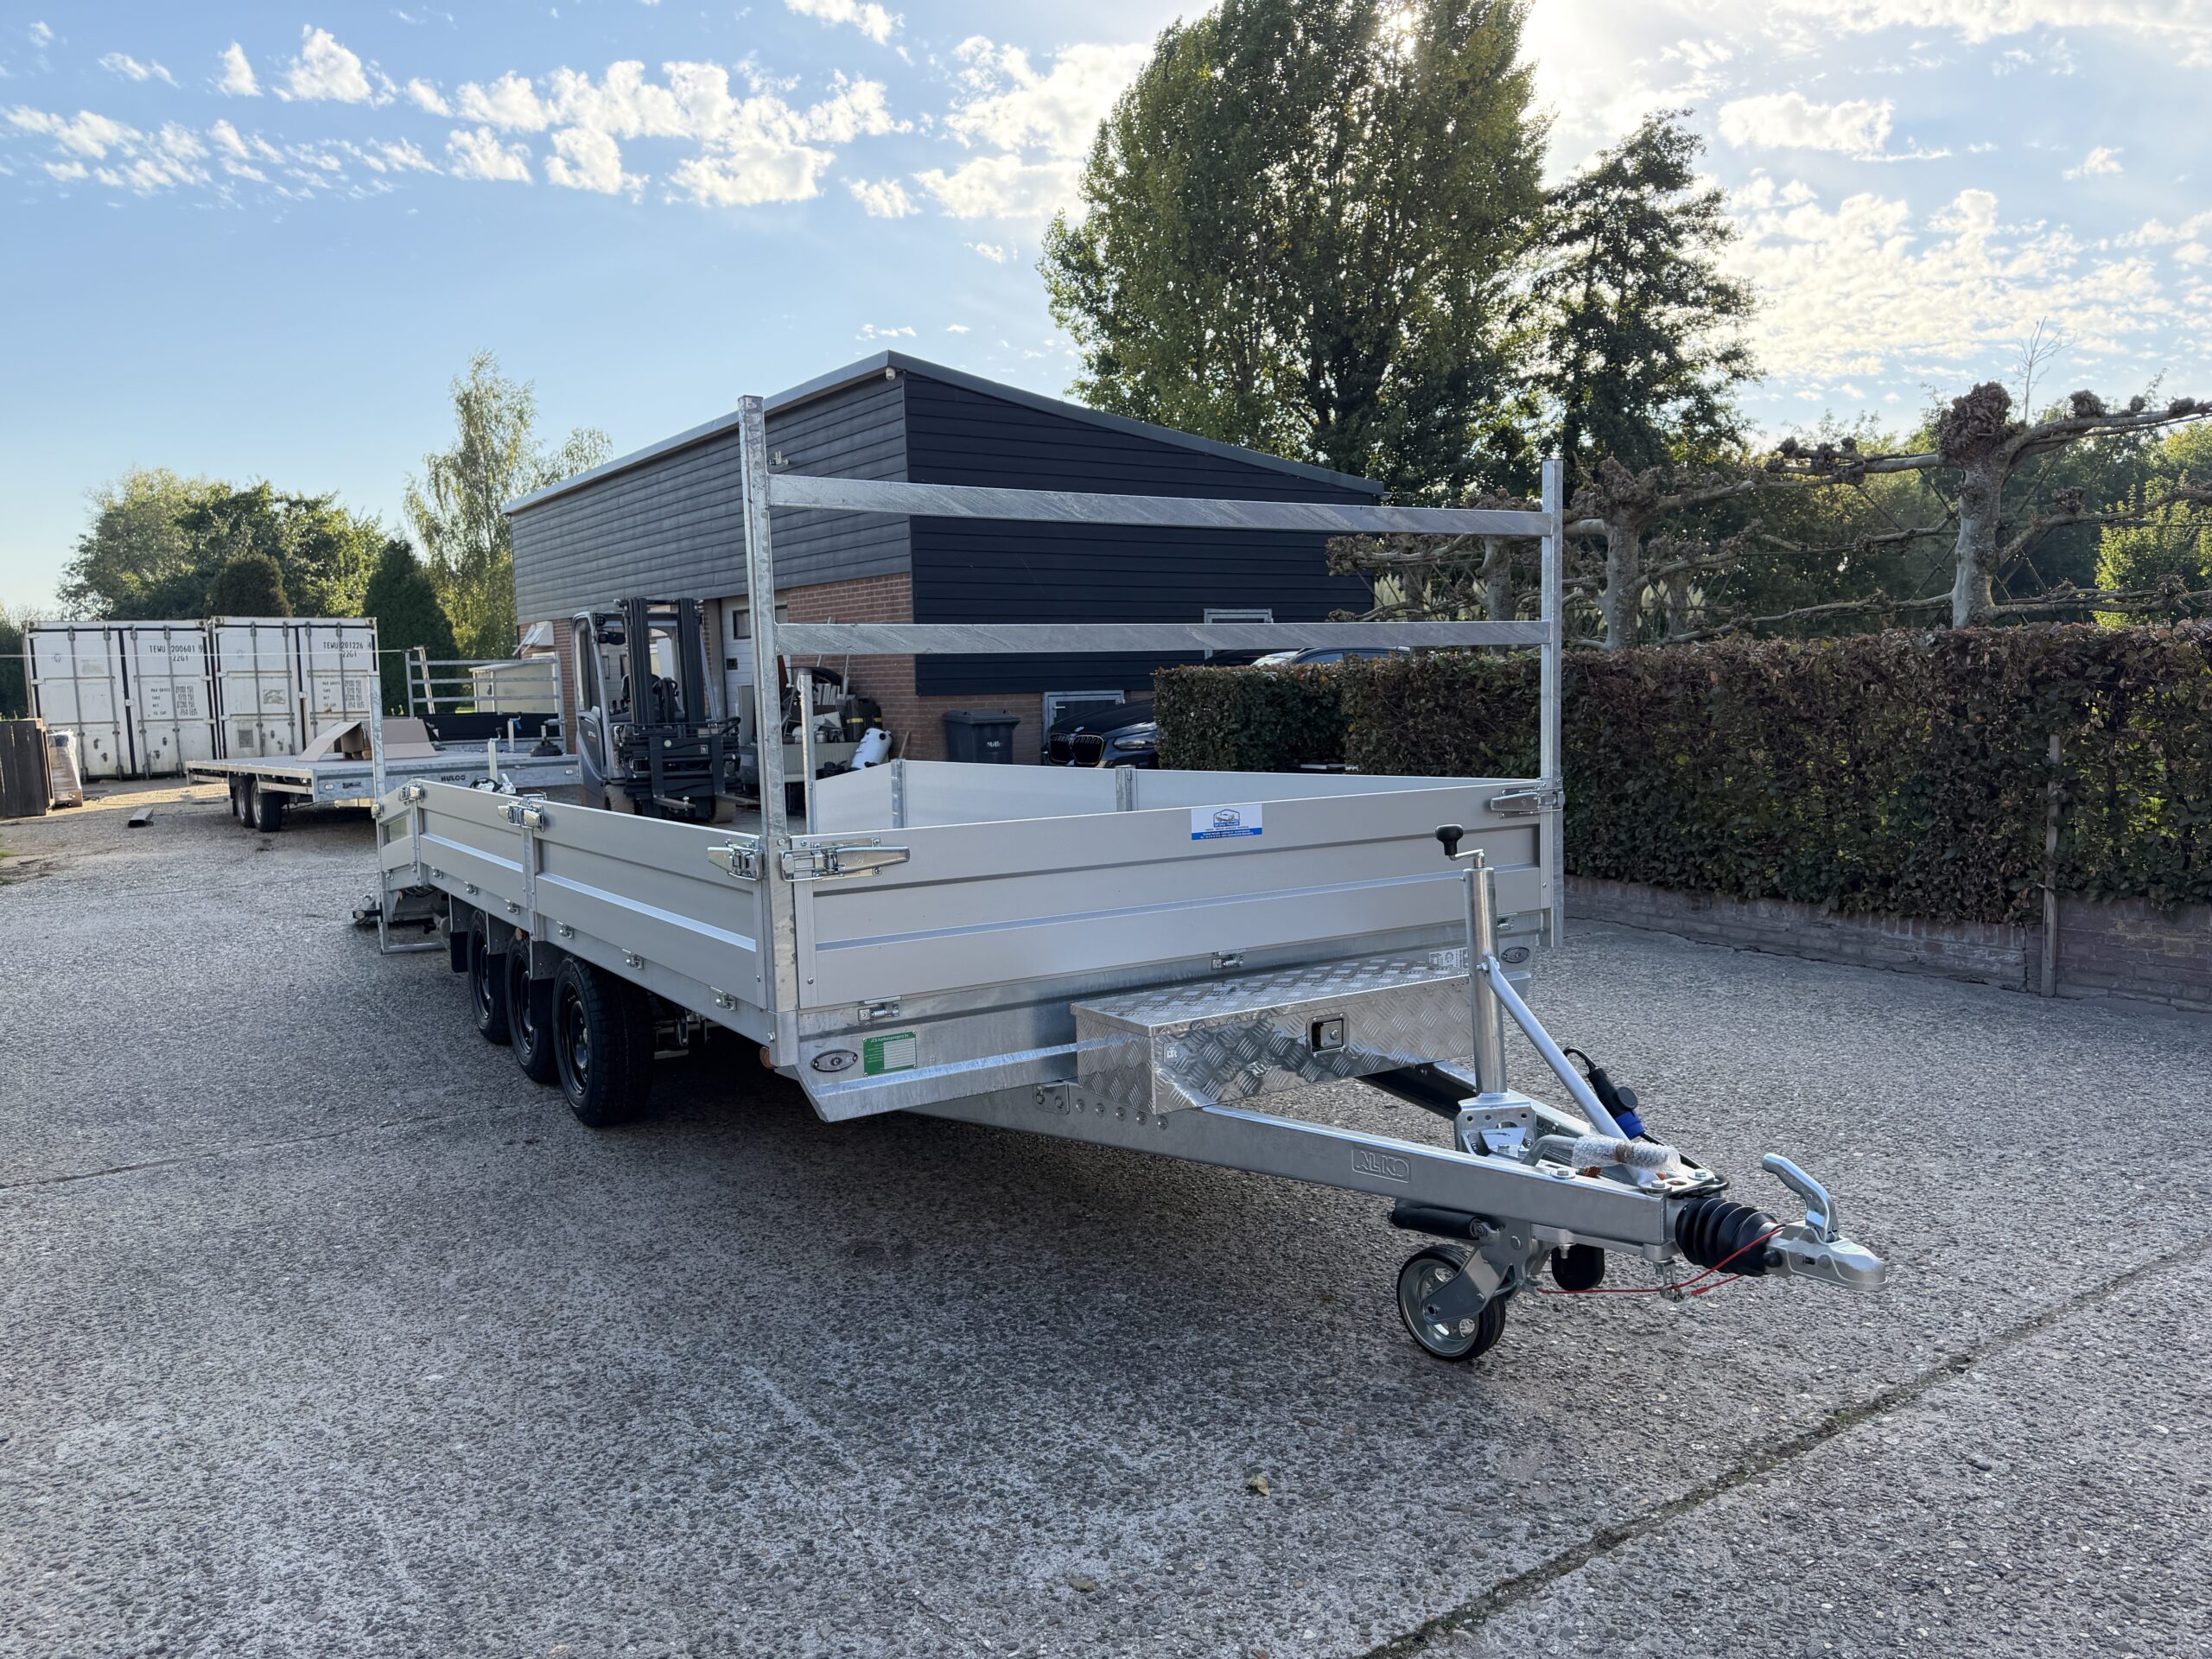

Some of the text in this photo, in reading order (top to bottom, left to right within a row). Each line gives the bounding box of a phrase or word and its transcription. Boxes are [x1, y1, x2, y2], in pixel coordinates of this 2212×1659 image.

[149, 645, 204, 653] TEWU 200601 9
[323, 641, 339, 650] TEWU
[340, 641, 364, 650] 201226
